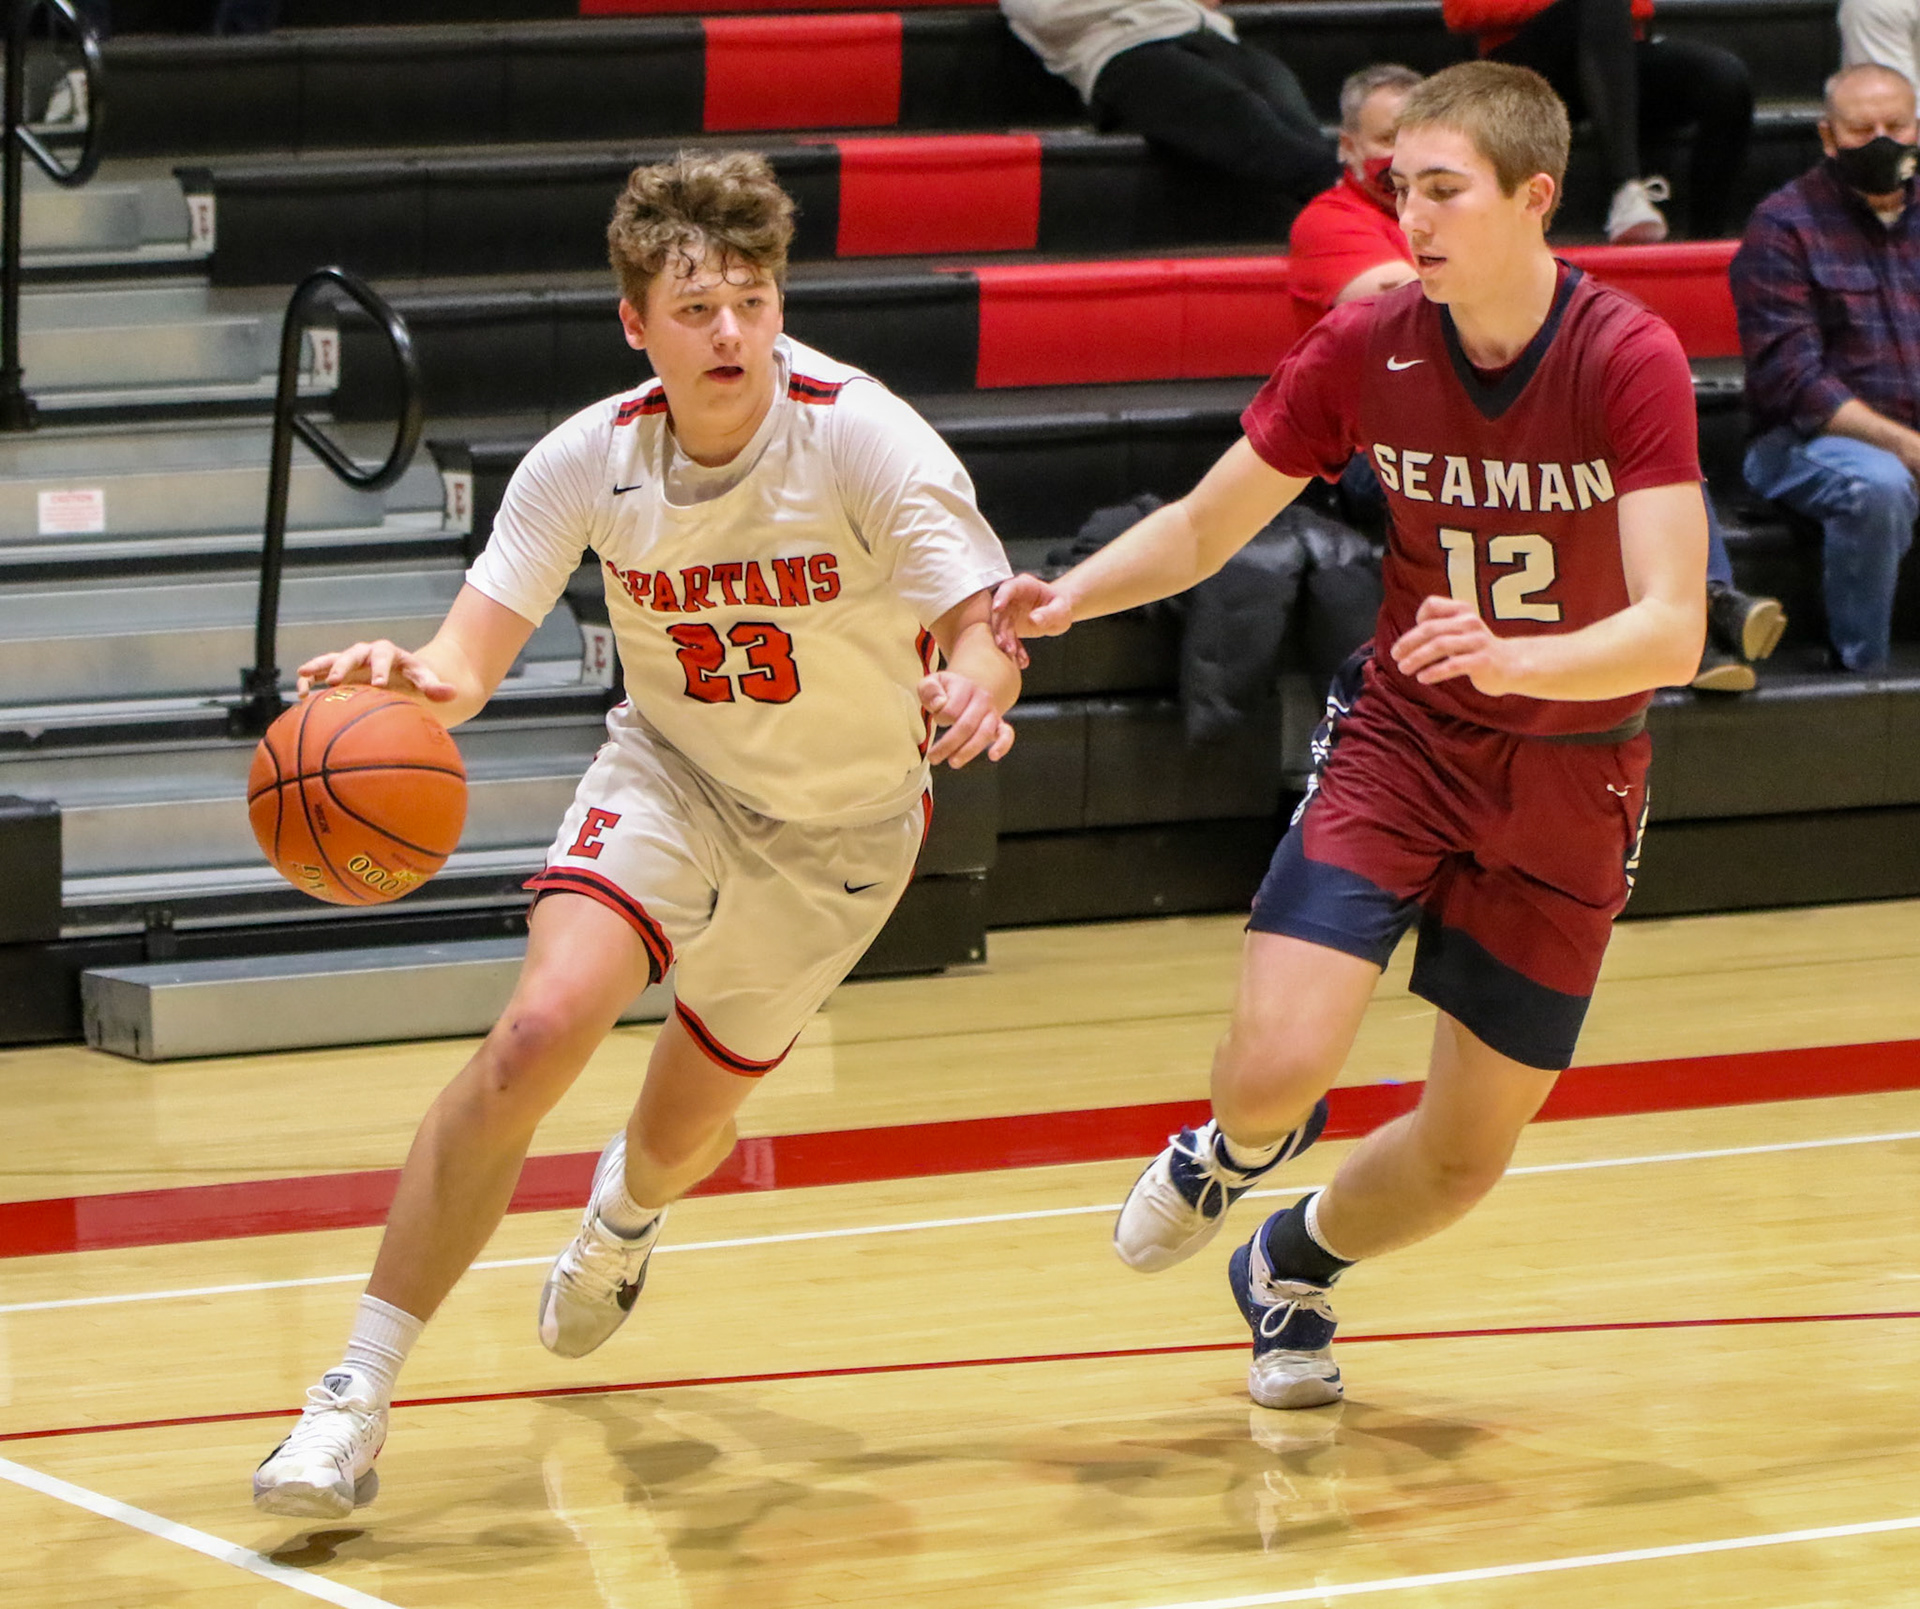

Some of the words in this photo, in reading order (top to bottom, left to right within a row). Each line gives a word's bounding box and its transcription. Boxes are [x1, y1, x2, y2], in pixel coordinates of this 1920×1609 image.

[1373, 443, 1616, 512] SEAMAN
[1438, 526, 1563, 622] 12
[666, 621, 801, 705] 23
[567, 807, 622, 860] E
